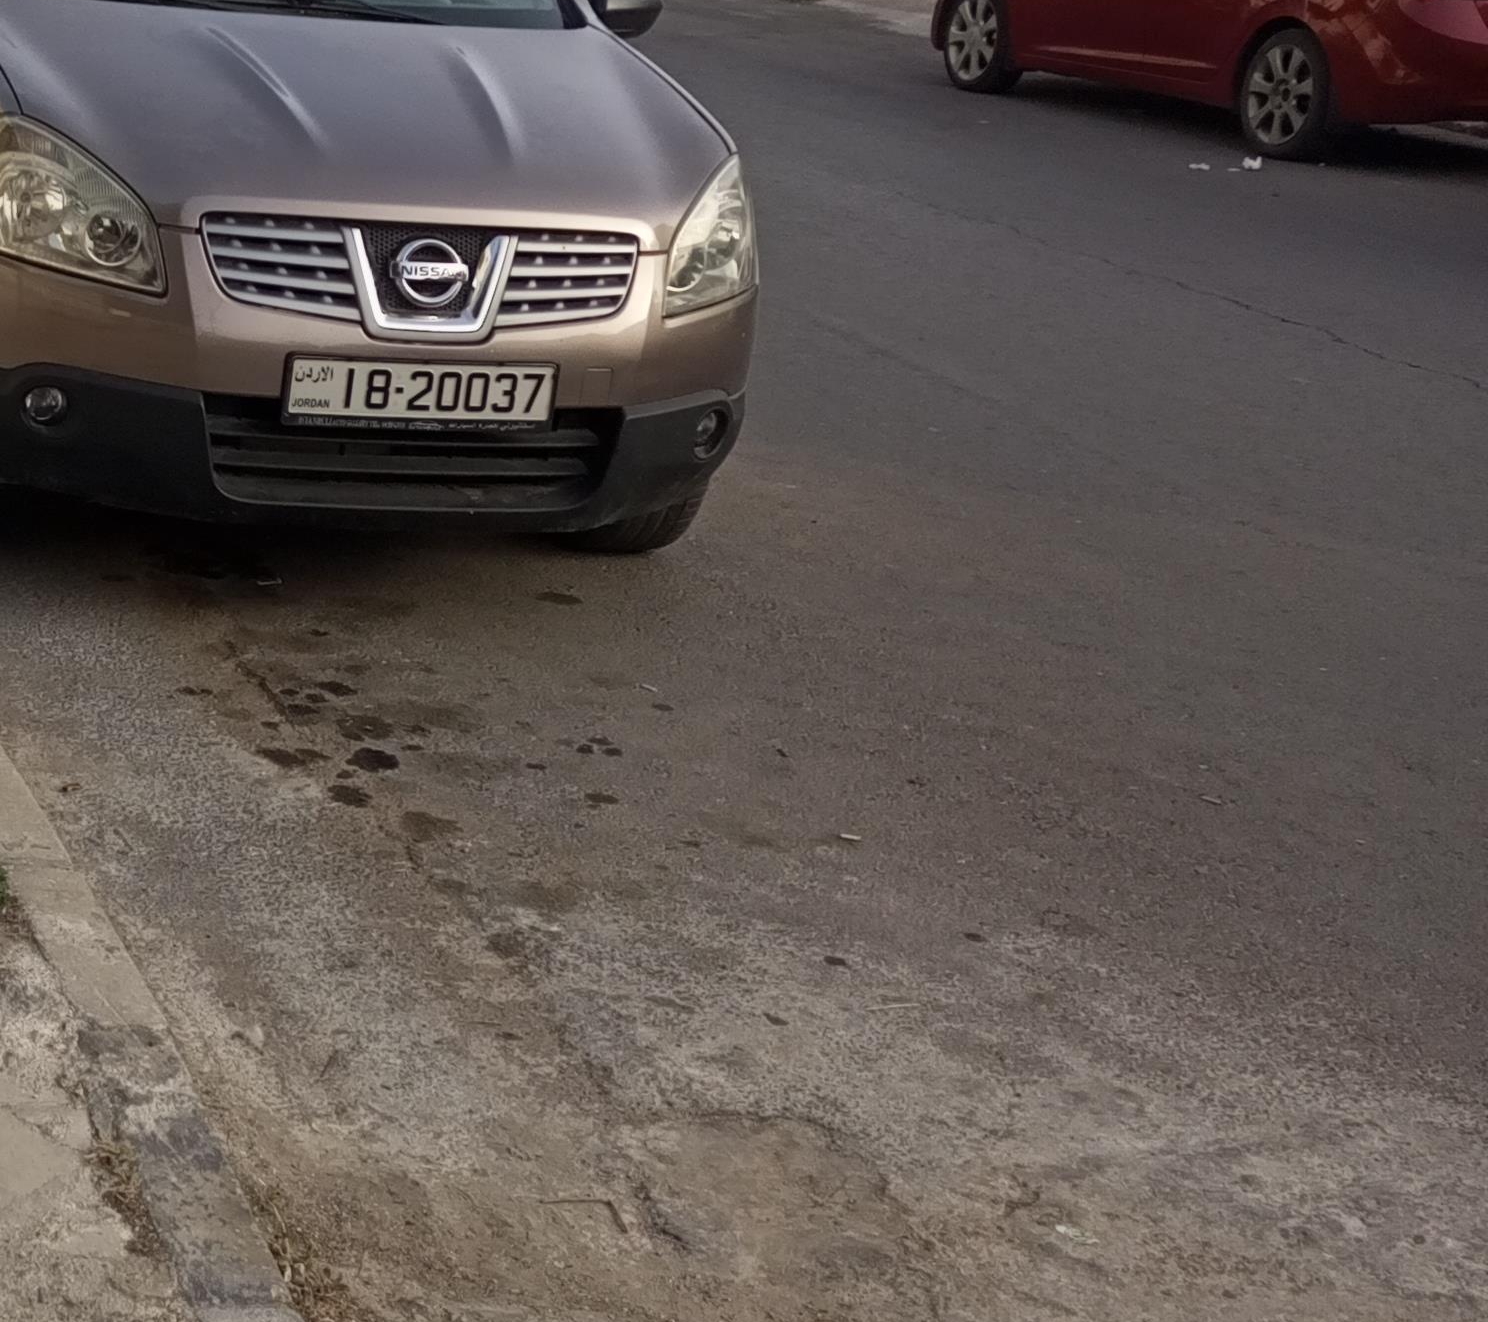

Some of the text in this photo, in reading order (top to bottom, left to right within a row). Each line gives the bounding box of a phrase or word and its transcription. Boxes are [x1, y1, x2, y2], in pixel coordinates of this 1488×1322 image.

[401, 265, 465, 278] NISSA
[295, 365, 334, 383] الاردن
[343, 367, 547, 414] 18-20037
[292, 397, 330, 409] JORDAN
